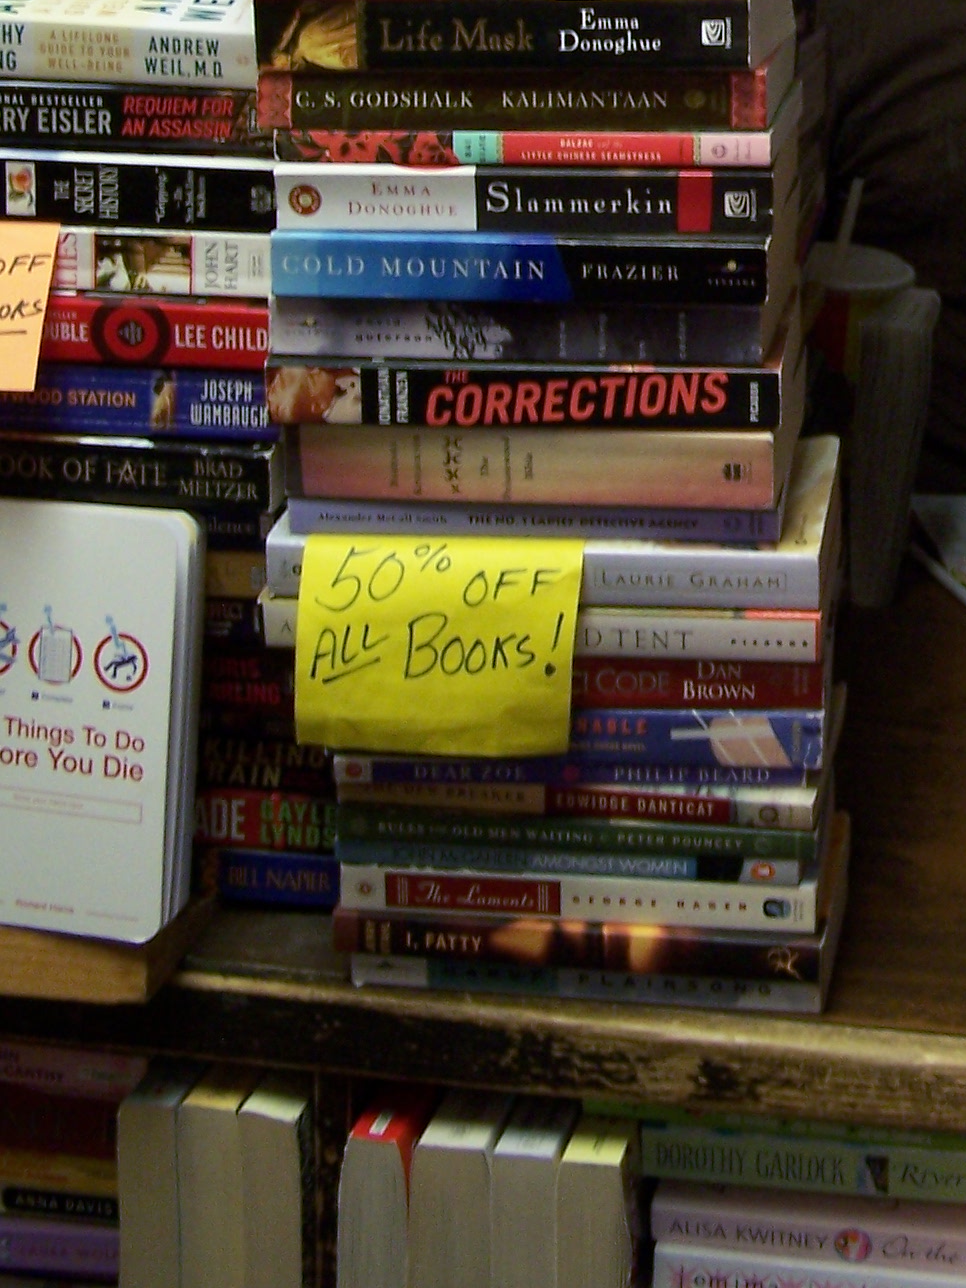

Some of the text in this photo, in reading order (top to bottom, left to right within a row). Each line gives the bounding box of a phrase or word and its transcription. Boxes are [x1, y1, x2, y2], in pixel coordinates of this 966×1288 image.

[579, 7, 640, 31] Emma
[148, 34, 220, 58] ANDREW
[558, 28, 662, 56] Donoghue
[122, 95, 235, 117] REQUIEM FOR
[294, 89, 668, 110] C. S. GODSHALK KALIMANTAAN
[37, 108, 113, 135] EISLER
[121, 118, 234, 139] AN ASSASSIN
[370, 184, 432, 199] EMMA
[485, 180, 673, 216] Slammerkin
[347, 201, 458, 219] DONOGHUE
[282, 255, 680, 282] COLD MOUNTAIN FRAZIER
[174, 323, 268, 352] LEE CHILD
[200, 378, 253, 403] JOSEPH
[424, 373, 729, 427] CORRECTIONS
[315, 542, 563, 613] 50% OFF
[310, 622, 391, 681] ALL
[682, 678, 757, 706] BROWN
[3, 715, 146, 754] Things To Do
[47, 747, 145, 781] You Die
